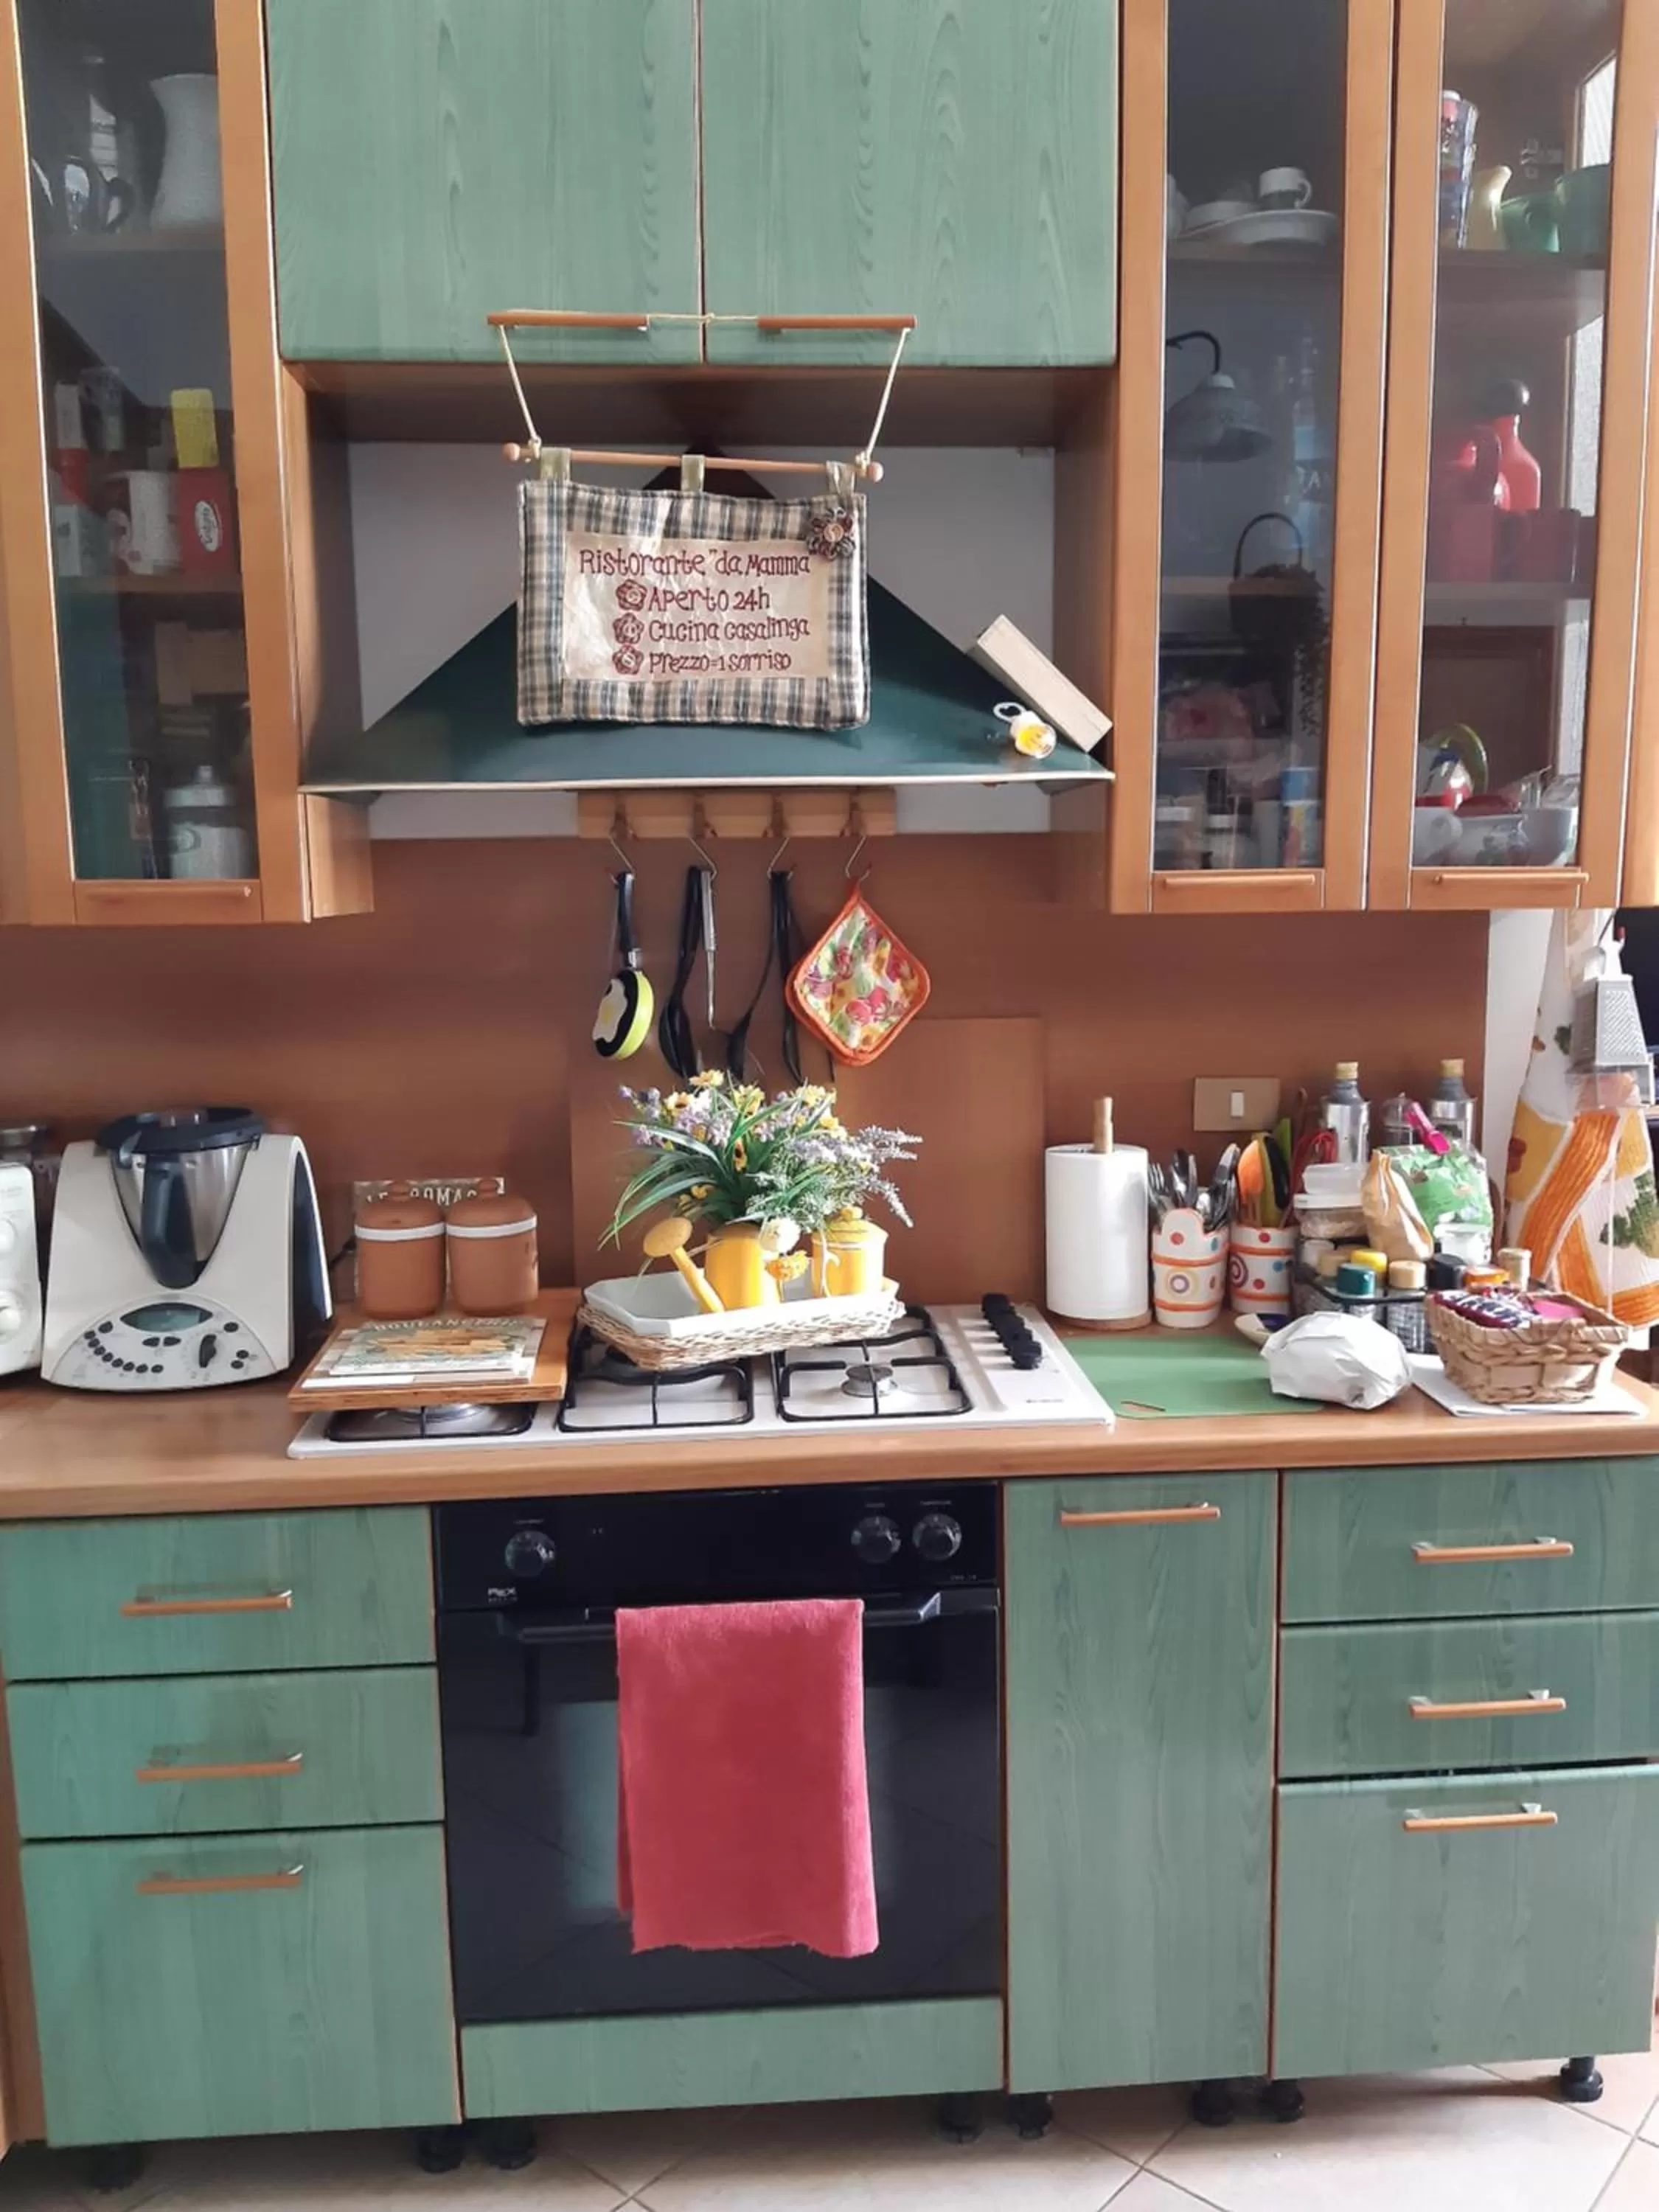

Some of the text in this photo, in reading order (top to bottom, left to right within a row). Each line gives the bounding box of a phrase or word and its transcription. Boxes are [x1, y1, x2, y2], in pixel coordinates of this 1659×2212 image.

[579, 548, 706, 576] Ristorante
[647, 585, 771, 612] Aperto 24h
[648, 616, 810, 642] Cucina casalinga
